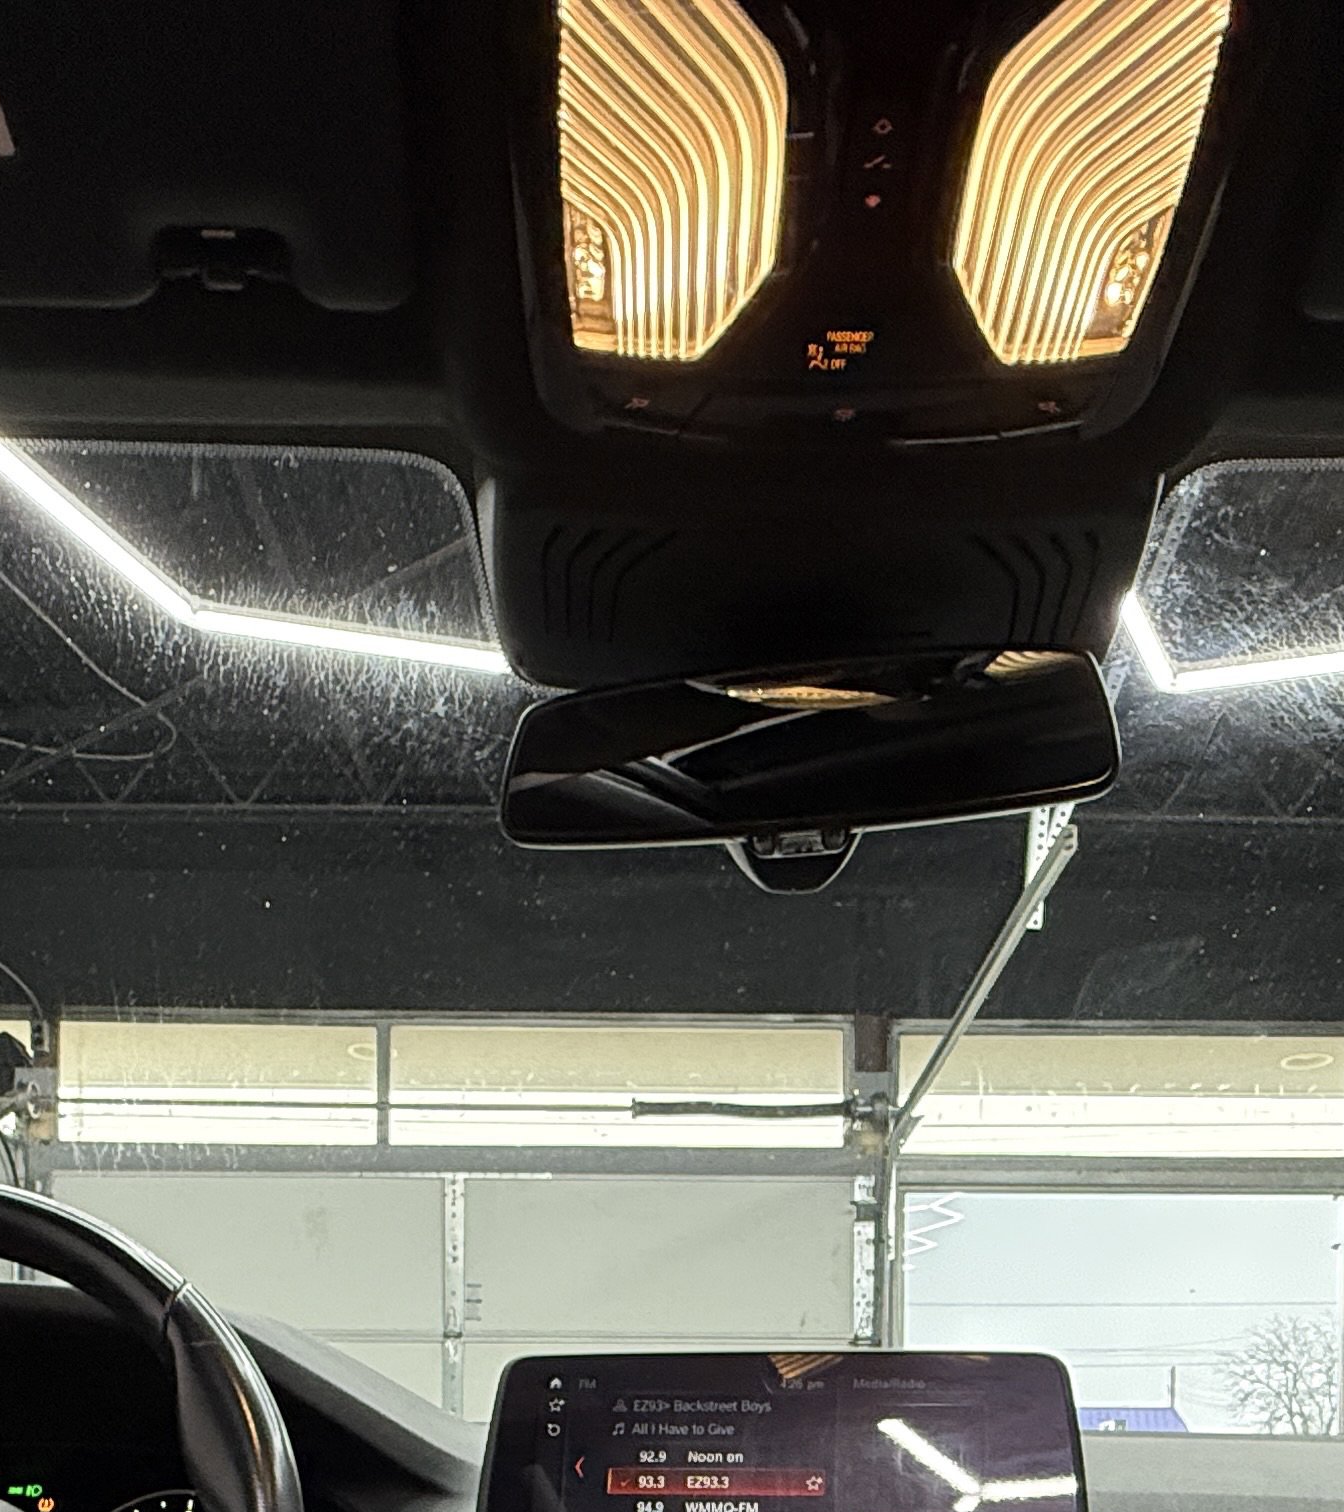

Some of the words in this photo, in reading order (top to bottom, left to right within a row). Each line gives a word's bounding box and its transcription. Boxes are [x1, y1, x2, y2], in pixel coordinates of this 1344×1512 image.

[826, 331, 874, 342] PASSENGER
[673, 1400, 737, 1412] Backstreet
[741, 1400, 772, 1414] Boys
[632, 1424, 648, 1435] All
[658, 1424, 688, 1435] Have
[692, 1424, 704, 1435] to
[707, 1424, 735, 1435] Give
[639, 1450, 667, 1463] 92.9
[687, 1450, 723, 1463] Noon
[726, 1453, 744, 1463] on
[638, 1476, 666, 1489] 93.3
[686, 1476, 730, 1489] EZ93.3
